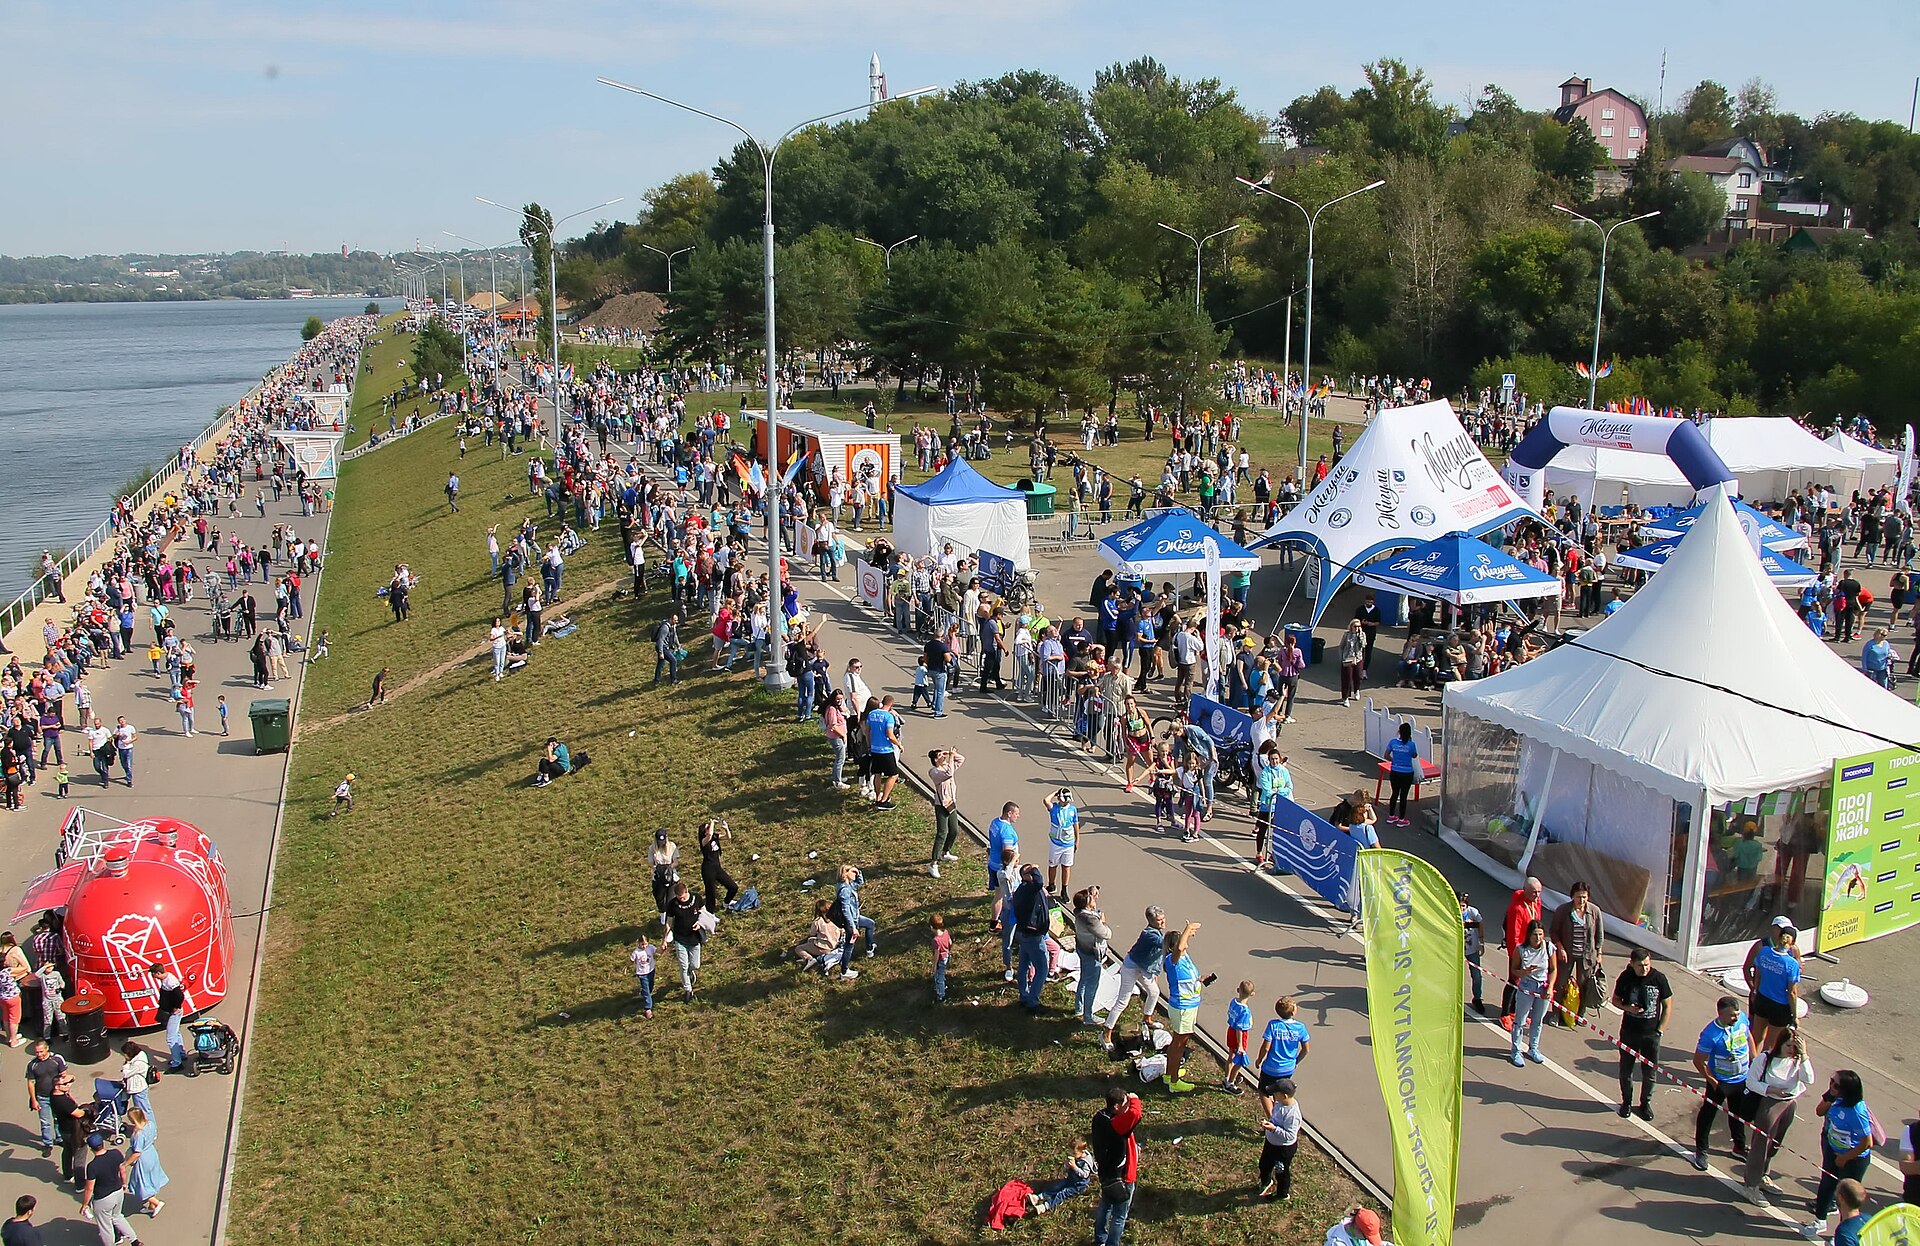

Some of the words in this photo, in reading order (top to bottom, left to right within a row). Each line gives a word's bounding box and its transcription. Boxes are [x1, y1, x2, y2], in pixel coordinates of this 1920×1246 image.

[1580, 418, 1633, 440] Жигули
[1411, 432, 1481, 493] Жигули
[1304, 465, 1349, 524] Жигули
[1375, 468, 1400, 529] Жигули
[1389, 558, 1449, 576] Жигули
[1469, 563, 1520, 581] Жигули
[1838, 793, 1866, 812] про
[1836, 807, 1864, 829] дол
[1827, 924, 1858, 940] СИЛАМИ!
[1833, 916, 1859, 929] НОВЫМИ
